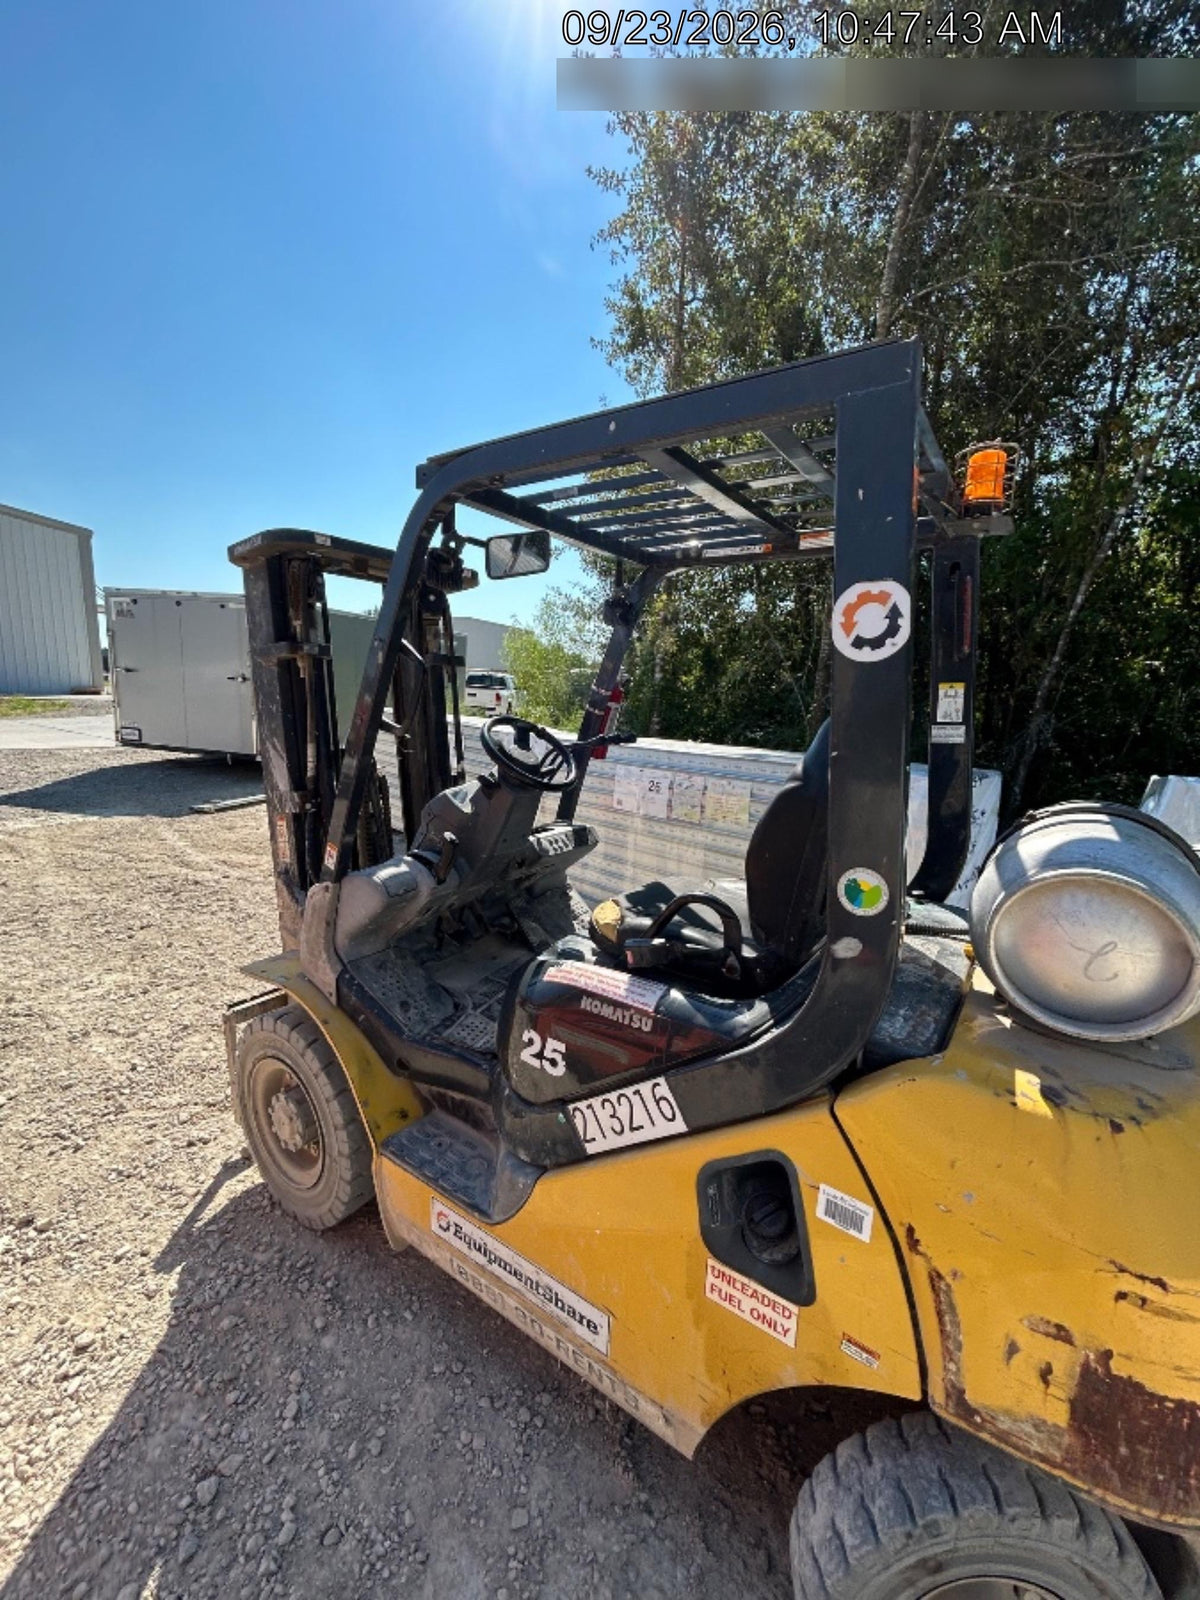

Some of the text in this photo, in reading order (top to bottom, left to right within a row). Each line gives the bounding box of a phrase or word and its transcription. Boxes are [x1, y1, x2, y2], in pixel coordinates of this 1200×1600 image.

[580, 995, 654, 1032] KOMATSU
[520, 1028, 567, 1077] 25
[571, 1082, 676, 1144] 213216
[452, 1221, 600, 1336] EquipmentShare
[710, 1264, 793, 1320] UNLEADED
[710, 1283, 791, 1338] FUEL ONLY
